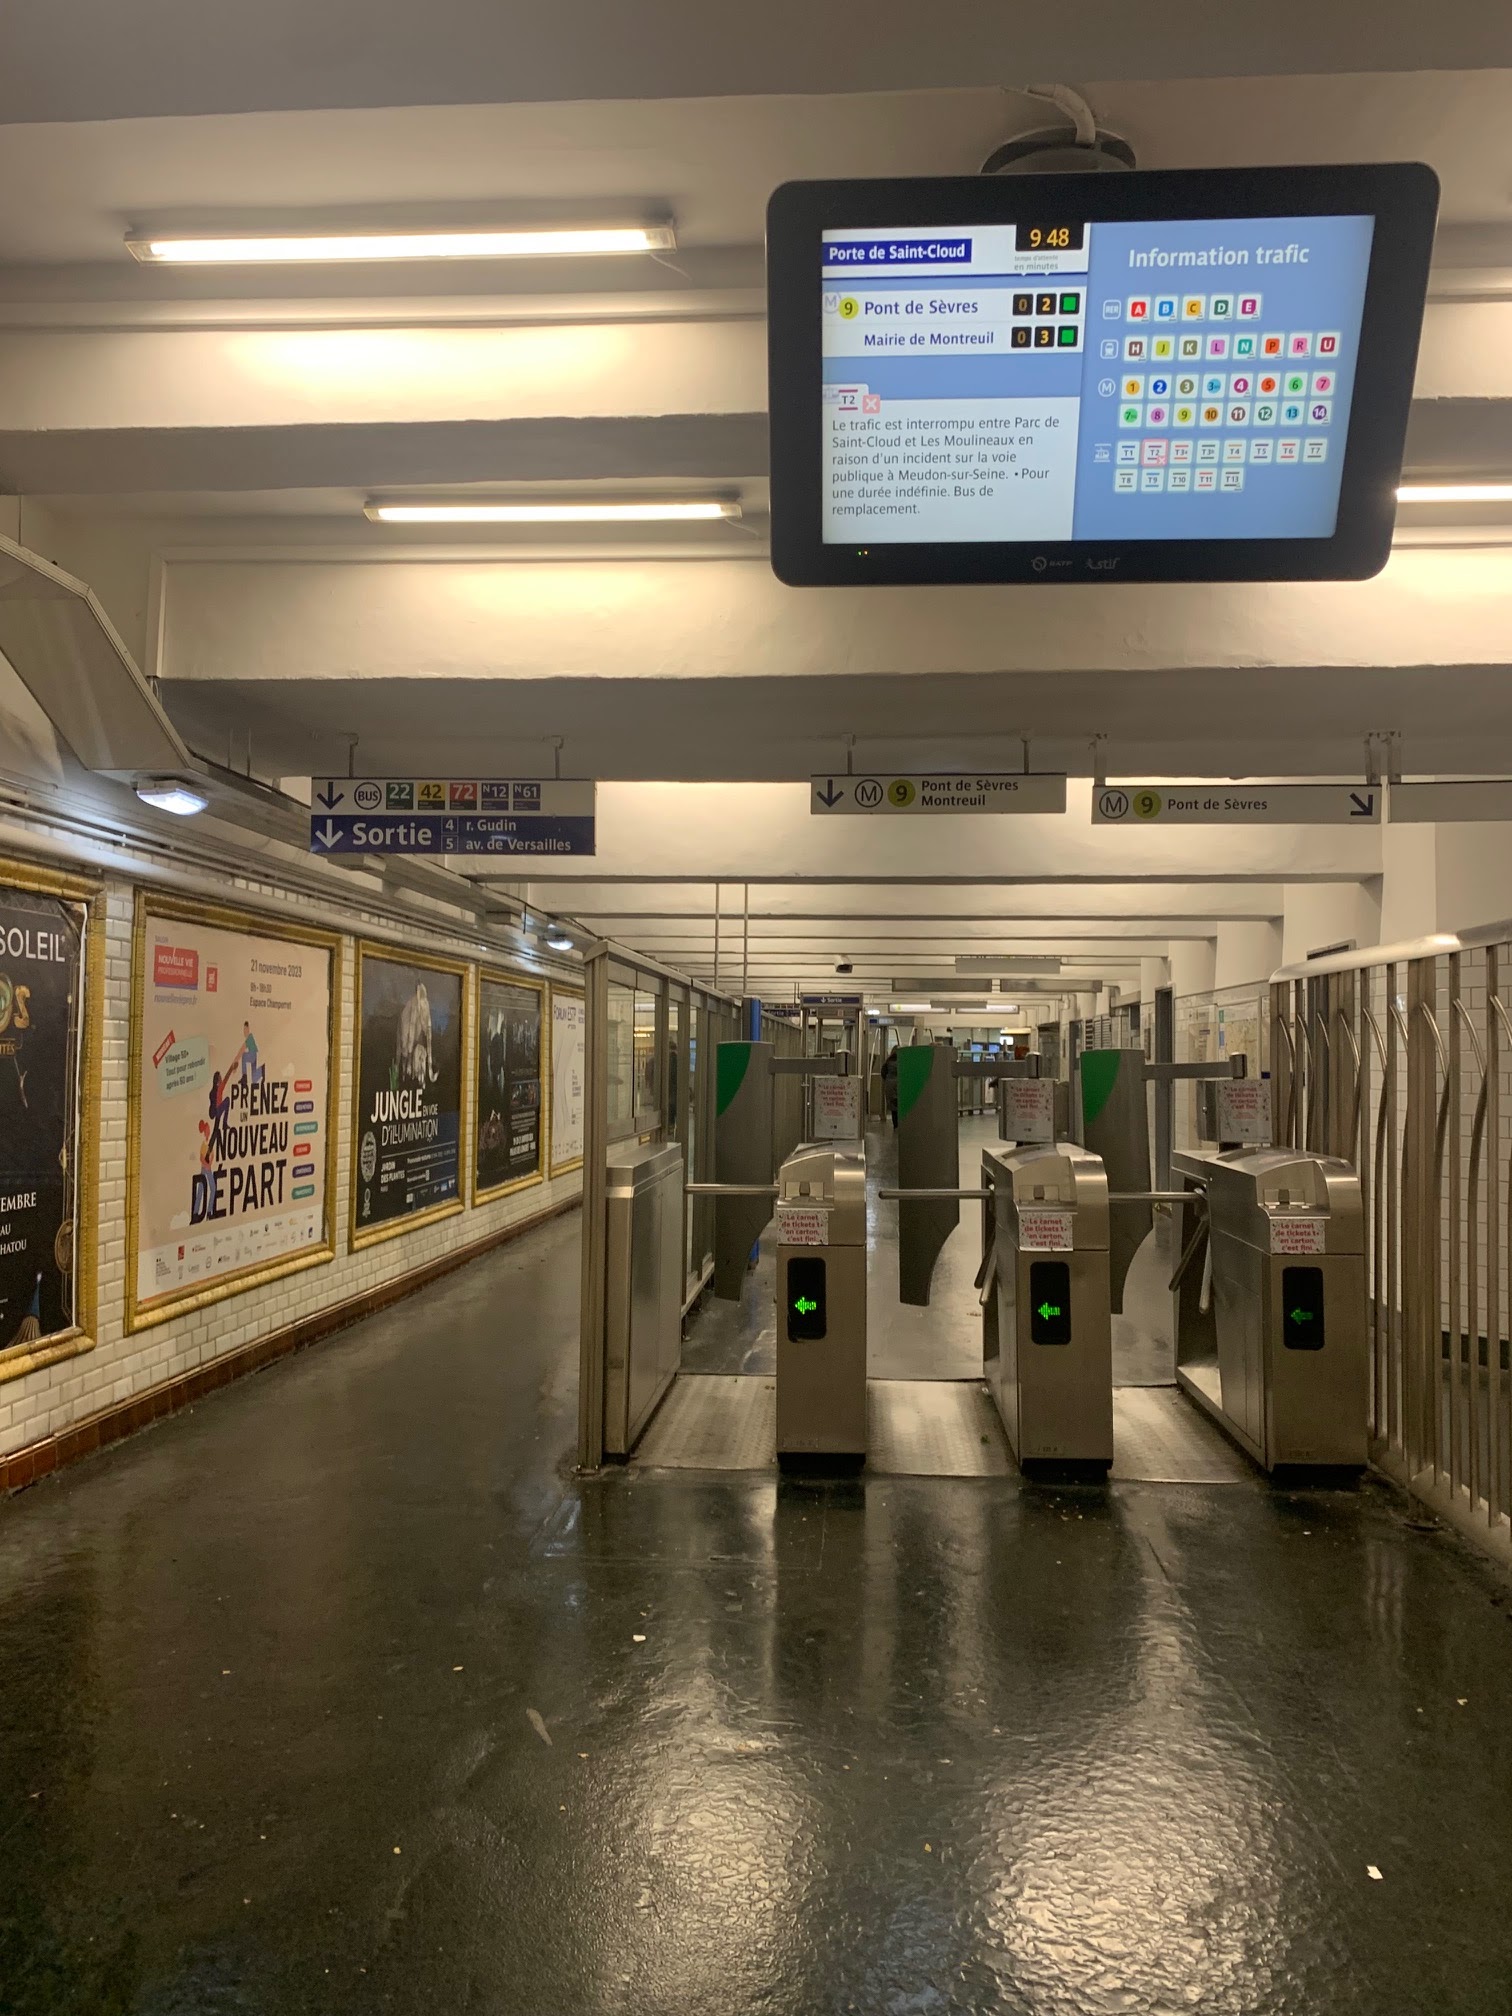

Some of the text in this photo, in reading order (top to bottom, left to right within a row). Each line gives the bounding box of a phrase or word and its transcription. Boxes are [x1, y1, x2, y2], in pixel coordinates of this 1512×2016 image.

[829, 243, 966, 260] Porte de Saint-Cloud
[1128, 244, 1310, 267] Information trafic
[1026, 262, 1059, 270] minutes
[844, 298, 978, 315] 9 Pont de Sèvres
[1134, 302, 1253, 314] A B C D E
[864, 331, 994, 346] Mairie de Montreuil
[1131, 344, 1140, 354] H
[1186, 343, 1194, 353] K
[1241, 341, 1249, 352] N
[1297, 340, 1304, 350] R
[1324, 339, 1333, 350] U
[1156, 382, 1163, 392] 2
[1183, 382, 1191, 391] 3
[1237, 380, 1245, 391] 4
[1265, 380, 1271, 390] 5
[1292, 380, 1299, 390] 6
[1320, 379, 1327, 389] 7
[842, 396, 855, 405] T2
[1154, 407, 1326, 420] 8 9 10 11 12 13 14
[832, 416, 1060, 432] Le trafic est interrompu entre Parc de
[832, 435, 1033, 448] Saint-Cloud et Les Moulineaux en
[832, 452, 1017, 465] raison d'un incident sur la voie
[1124, 449, 1133, 457] T1
[1150, 449, 1159, 457] T2
[1230, 448, 1240, 456] T4
[1257, 447, 1266, 456] T5
[1284, 447, 1293, 455] T6
[1311, 446, 1320, 455] T7
[832, 468, 1050, 483] publique à Meudon-sur-Seine. Pour
[1122, 475, 1239, 485] T8 T9 T10 T11 T13
[832, 485, 994, 498] une durée indéfinie. Bus de
[832, 503, 920, 517] remplacement.
[357, 783, 538, 802] BUS 22 42 72 N12 N61
[896, 784, 908, 801] 9
[921, 780, 952, 792] Pont
[956, 780, 972, 792] de
[976, 778, 1018, 792] Sèvres
[921, 794, 986, 807] Montreuil
[1140, 797, 1153, 814] 9
[1168, 798, 1199, 811] Pont
[1203, 798, 1221, 811] de
[1224, 797, 1268, 811] Sèvres
[445, 819, 517, 832] 4 r. Gudin
[352, 822, 432, 846] Sortie
[446, 838, 571, 852] 5 av. de Versailles
[251, 959, 303, 978] 21 novembre 2023
[230, 1081, 289, 1117] PRENEZ
[370, 1089, 423, 1124] JUNGLE
[240, 1111, 248, 1123] UN
[215, 1121, 289, 1162] NOUVEAU
[189, 1158, 287, 1226] DÉPART
[792, 1220, 815, 1228] tickets
